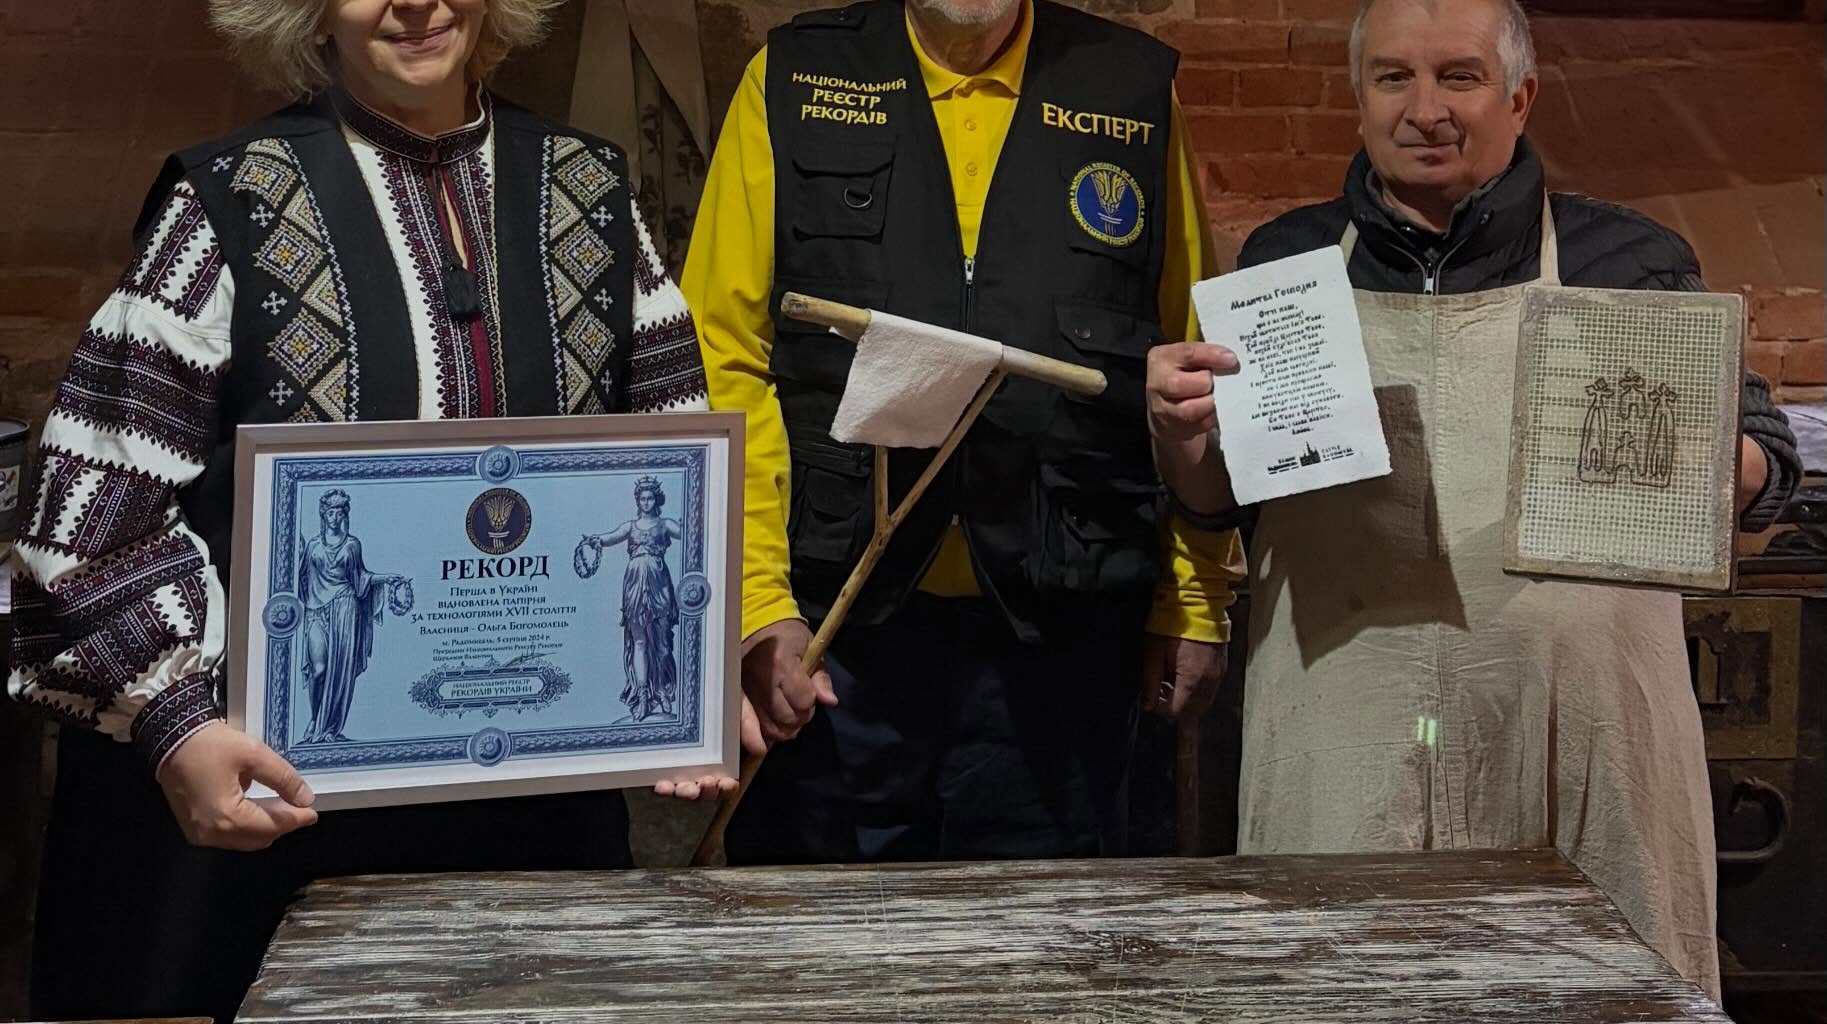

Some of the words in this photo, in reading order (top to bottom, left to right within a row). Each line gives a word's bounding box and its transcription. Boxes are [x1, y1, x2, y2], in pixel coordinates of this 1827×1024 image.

[792, 72, 907, 92] НАЦІОНАЛЬНИЙ
[812, 88, 881, 109] РЕЄСТР
[801, 104, 887, 125] РЕКОРДІВ
[1041, 102, 1155, 145] ЕКСПЕРТ
[1231, 294, 1272, 310] Молитва
[1274, 280, 1317, 298] Господня
[440, 555, 549, 580] РЕКОРД
[505, 606, 529, 617] XVII
